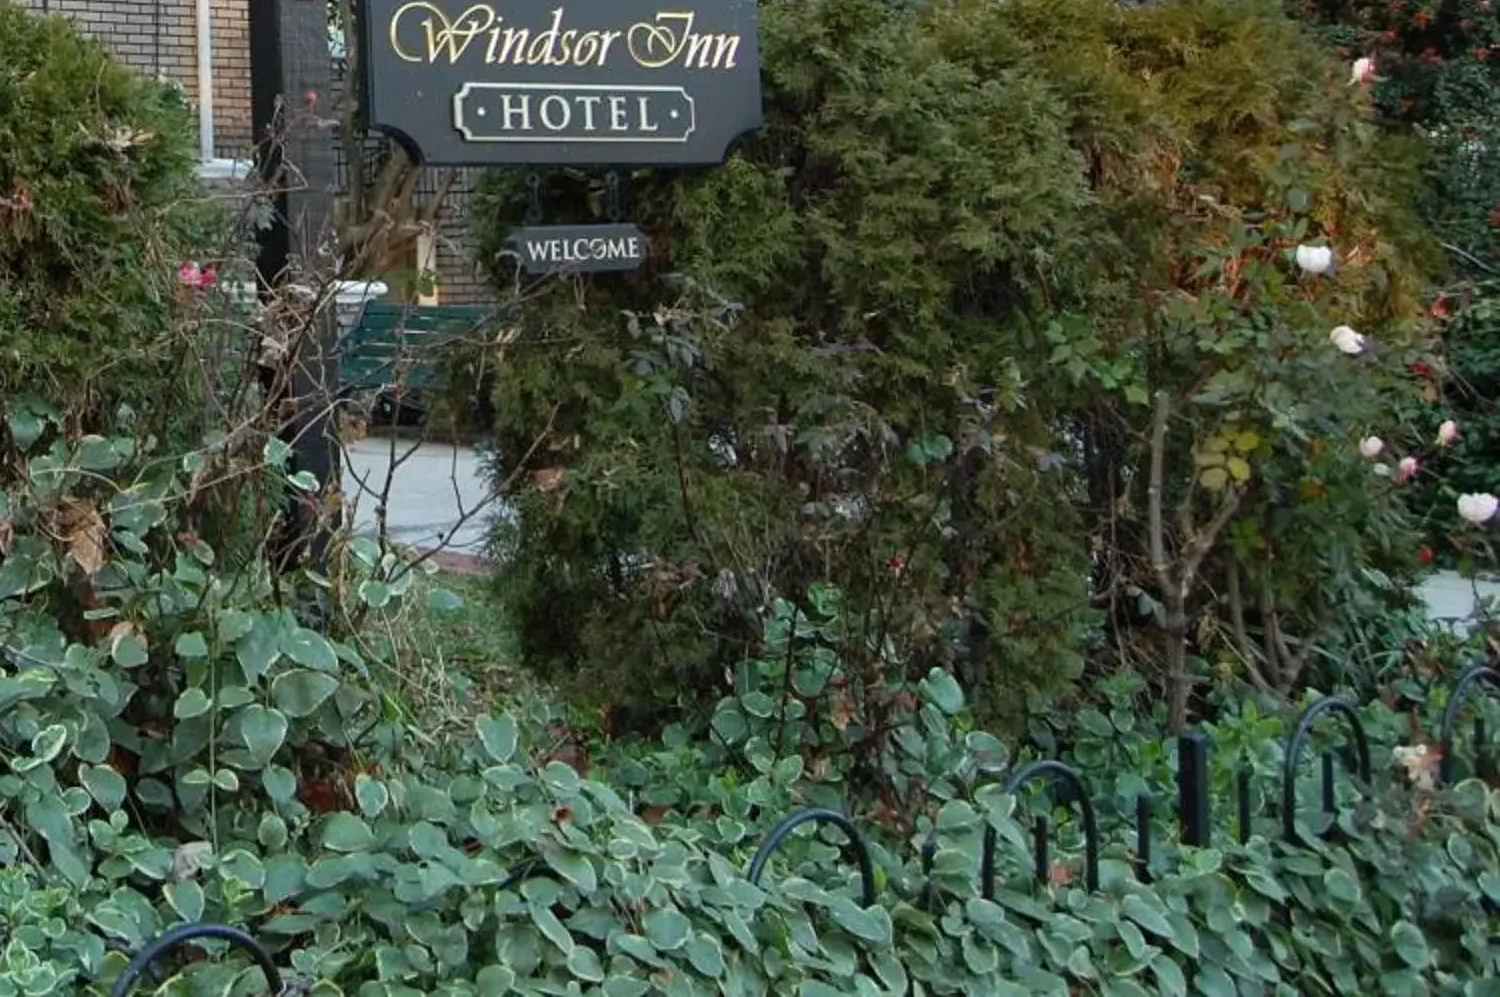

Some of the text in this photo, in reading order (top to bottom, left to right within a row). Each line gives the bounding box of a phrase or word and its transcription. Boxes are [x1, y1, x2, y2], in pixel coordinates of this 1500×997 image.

[390, 0, 741, 69] Windsor Inn
[500, 94, 659, 131] HOTEL
[526, 236, 640, 262] WELCOME
